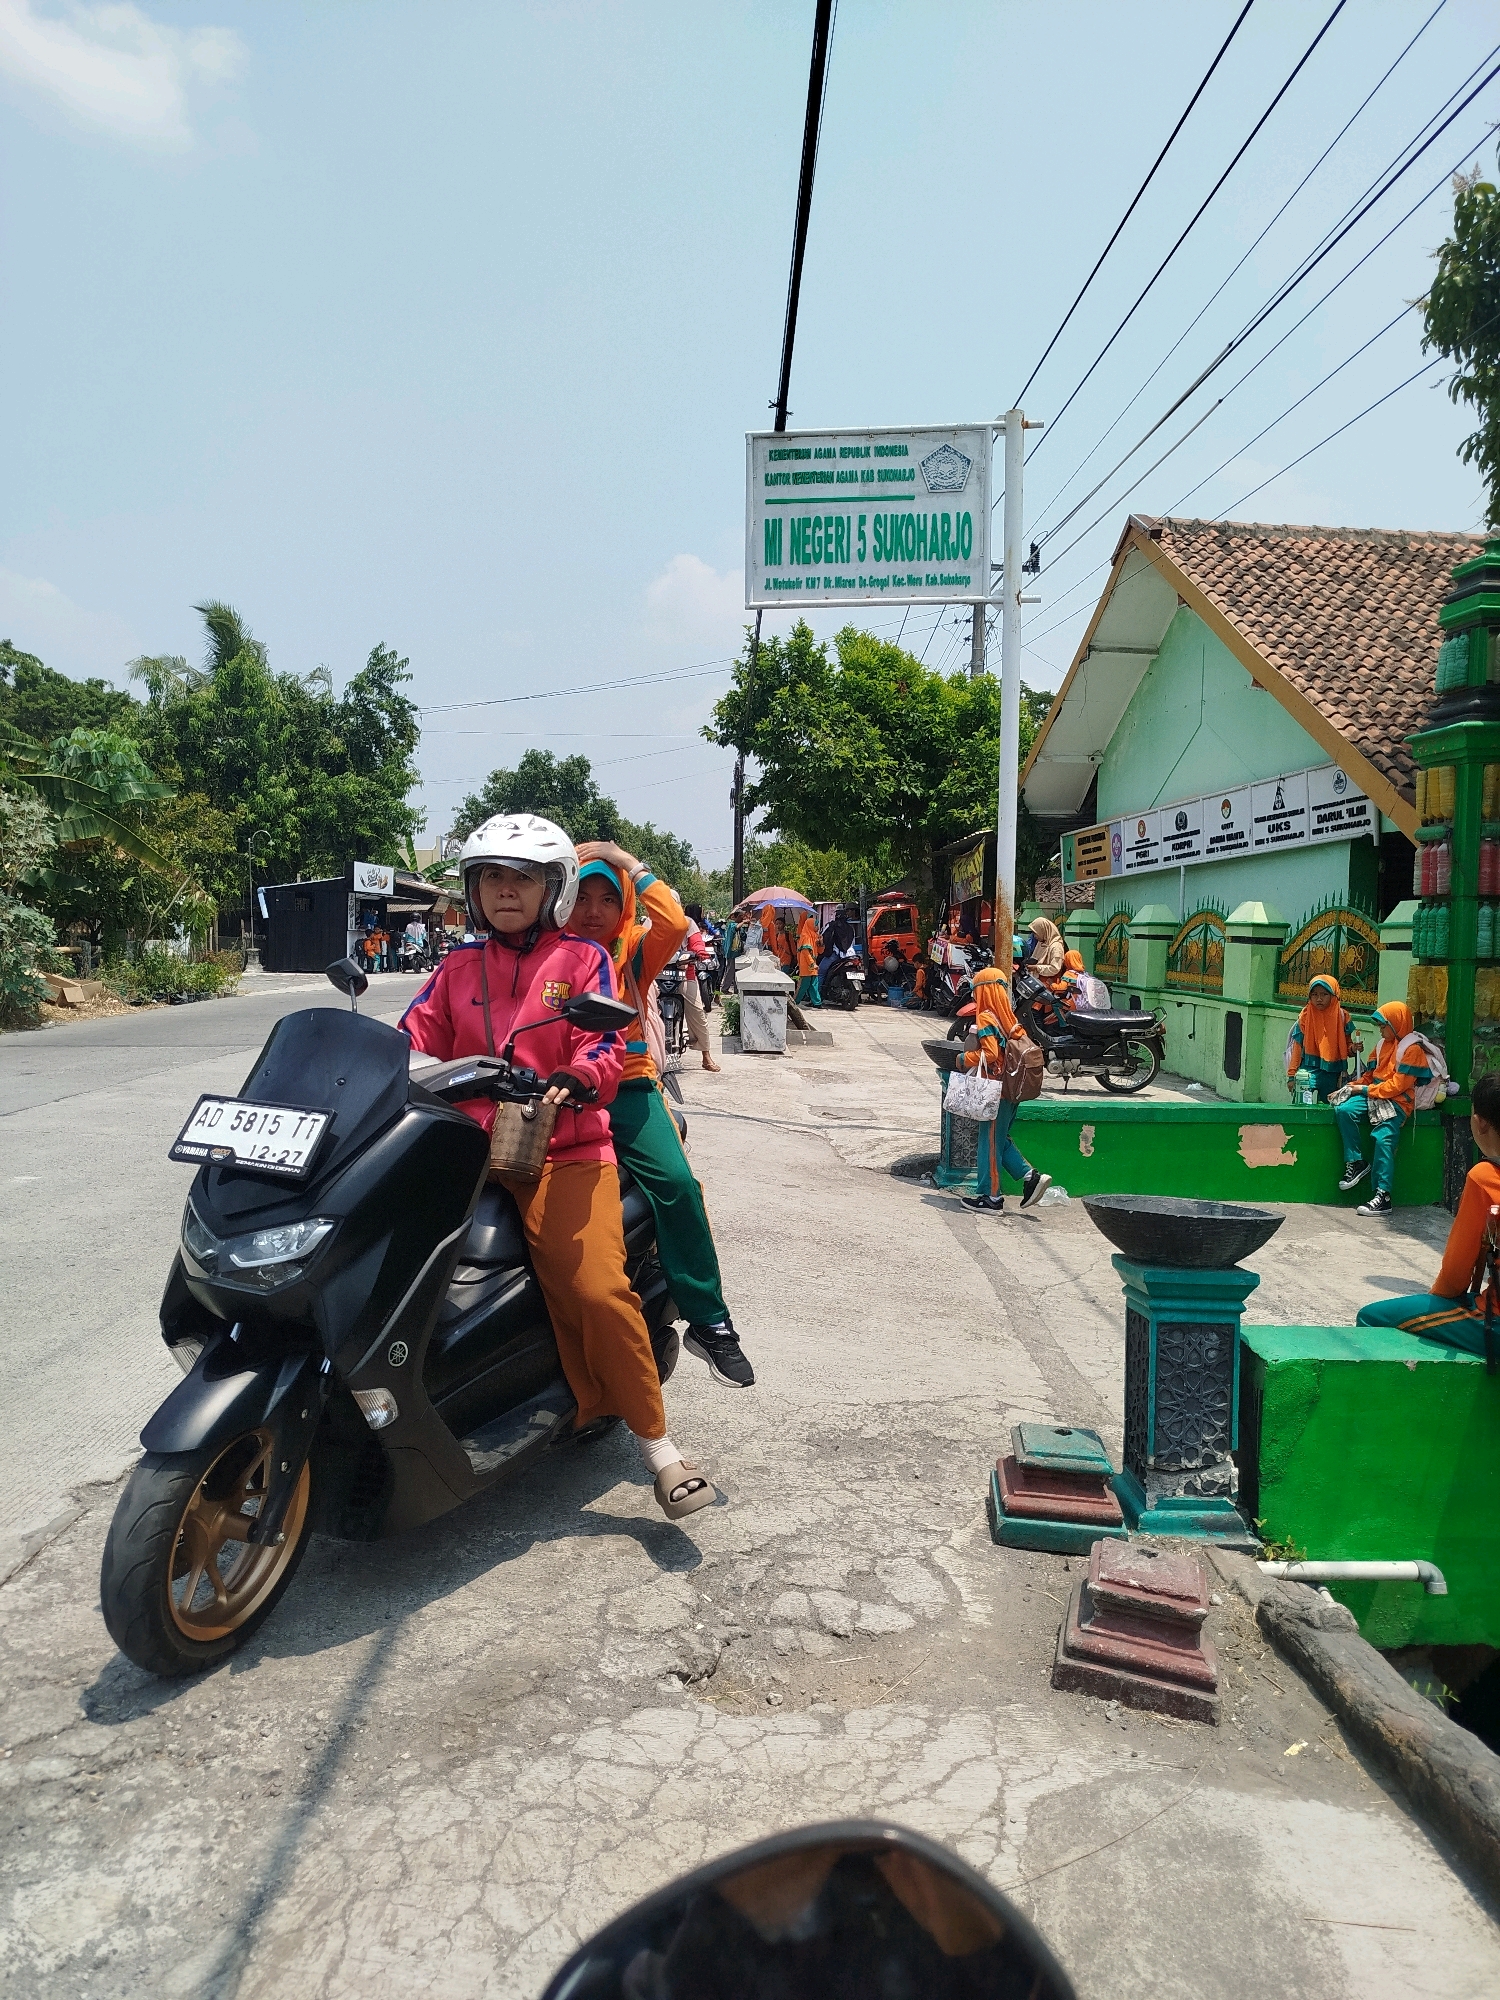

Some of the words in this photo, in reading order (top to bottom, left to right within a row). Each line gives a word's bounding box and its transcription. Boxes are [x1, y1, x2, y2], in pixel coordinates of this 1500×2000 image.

[814, 447, 836, 459] AGAMA
[840, 446, 871, 458] REPUBLIK
[874, 445, 909, 457] INDONESIA
[765, 472, 791, 486] KANTOR
[836, 470, 858, 483] AGAMA
[861, 469, 875, 482] KAB
[877, 468, 915, 482] SUKOHARJO
[764, 518, 782, 566] MI
[790, 515, 851, 565] NEGERI
[857, 514, 867, 563] 5
[873, 511, 972, 563] SUKOHARJO
[1317, 810, 1344, 824] DARUL
[1268, 821, 1291, 833] UKS
[1330, 819, 1371, 832] SUKOHARJO
[1270, 831, 1305, 843] SUKOHARJO
[195, 1107, 224, 1128] AD
[230, 1110, 284, 1136] 5815
[292, 1116, 320, 1140] TT
[182, 1145, 209, 1157] YAMAHA
[235, 1159, 267, 1168] SEMAKIN
[275, 1165, 301, 1174] DEPAN
